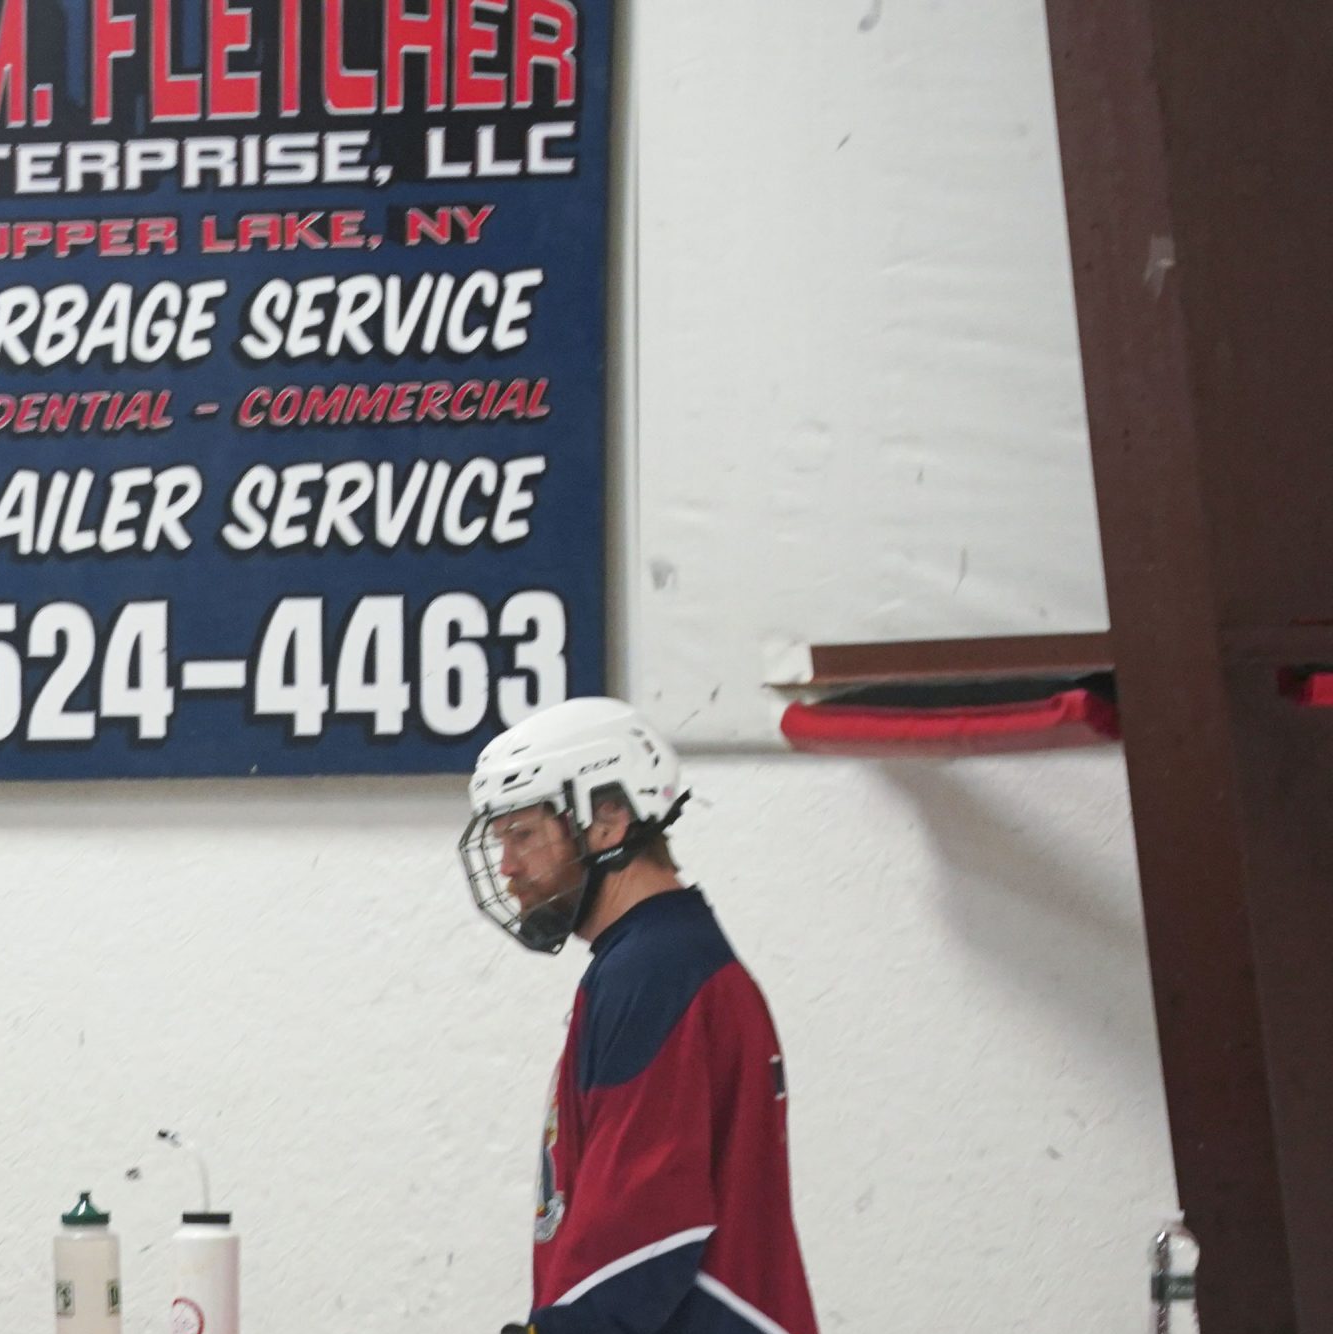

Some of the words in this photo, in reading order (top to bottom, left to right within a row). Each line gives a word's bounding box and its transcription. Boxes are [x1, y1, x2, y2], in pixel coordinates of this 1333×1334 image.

[427, 122, 574, 178] LLC
[197, 205, 386, 256] LAKE,
[401, 202, 499, 250] NY
[240, 269, 543, 359] SERVICE
[237, 374, 553, 428] COMMERCIAL
[222, 456, 546, 550] SERVICE
